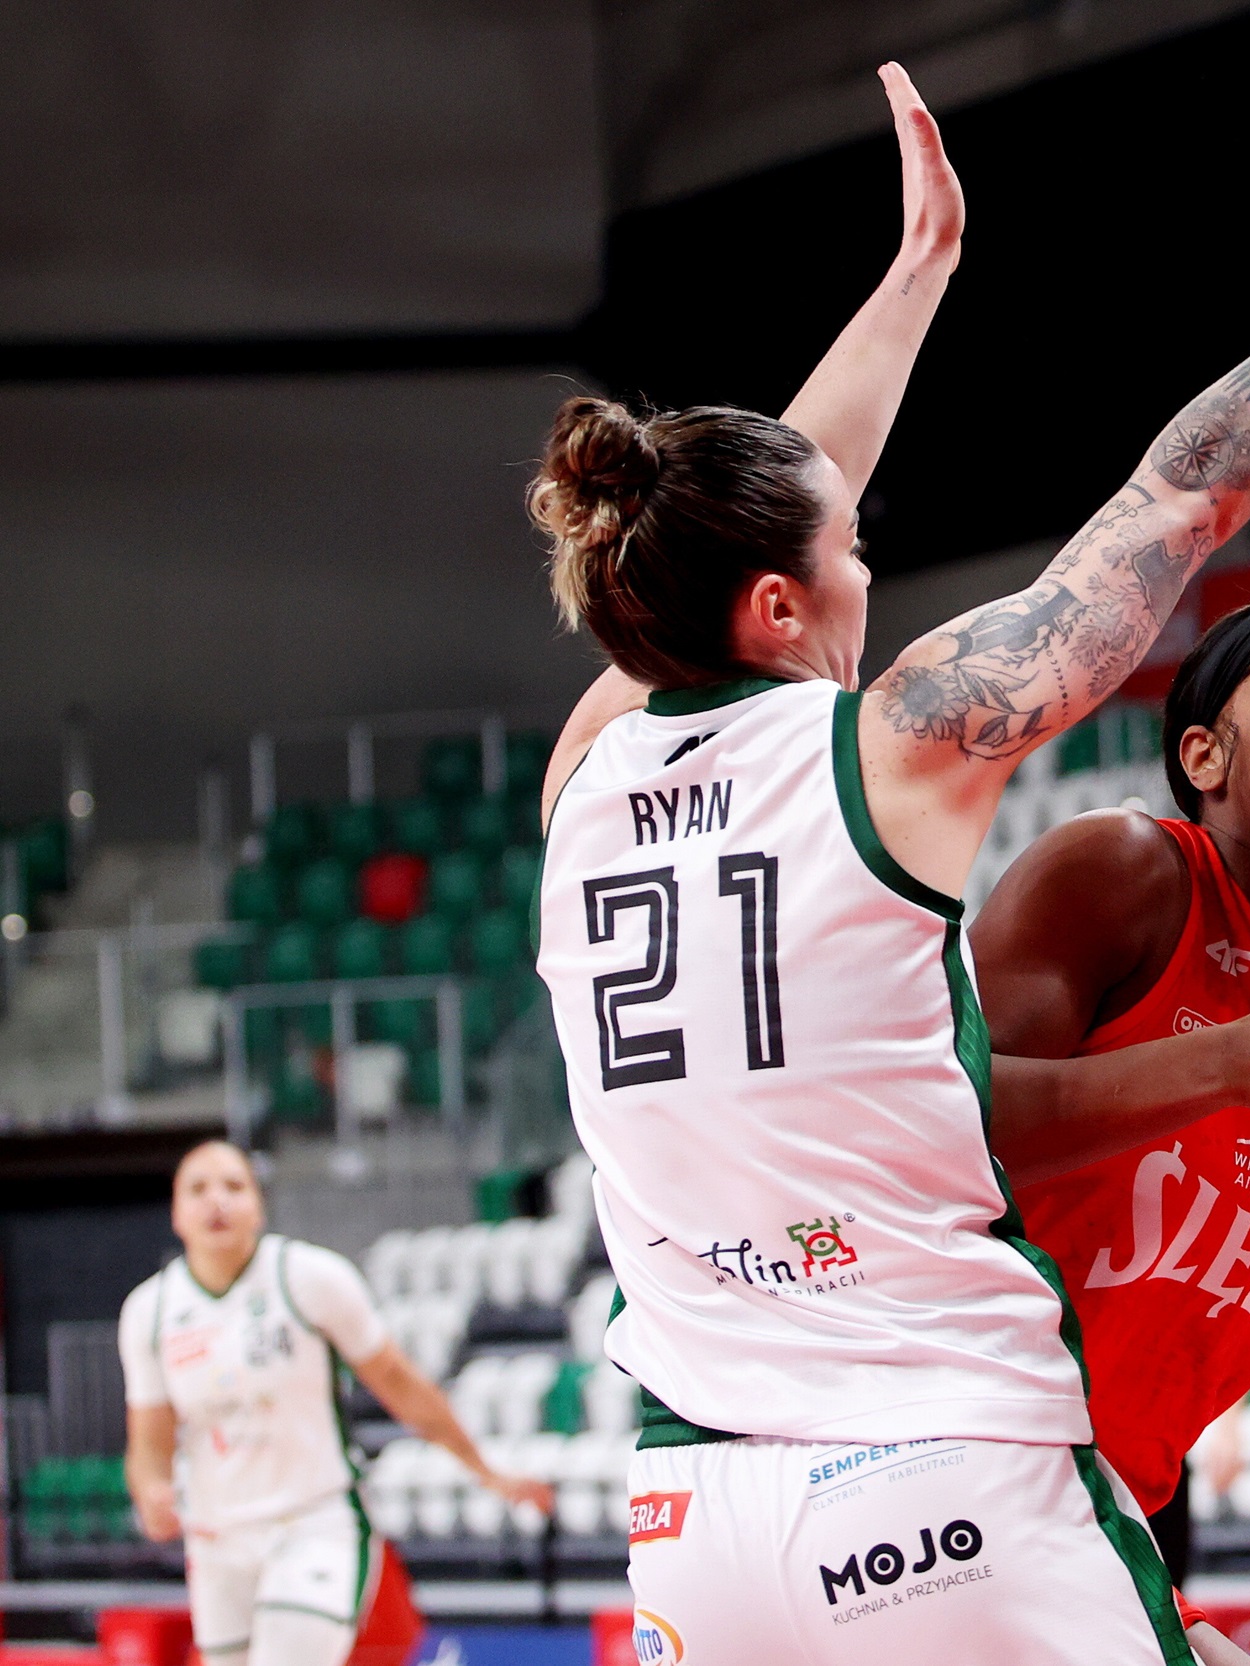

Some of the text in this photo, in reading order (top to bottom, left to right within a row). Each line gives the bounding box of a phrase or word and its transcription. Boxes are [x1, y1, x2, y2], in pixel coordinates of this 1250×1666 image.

[628, 779, 733, 846] RYAN
[582, 851, 786, 1092] 21
[808, 1444, 899, 1485] SEMPER
[629, 1500, 673, 1535] ERŁA
[819, 1519, 983, 1605] MOJO
[832, 1563, 993, 1626] KUCHNIA & PRZYJACIELE
